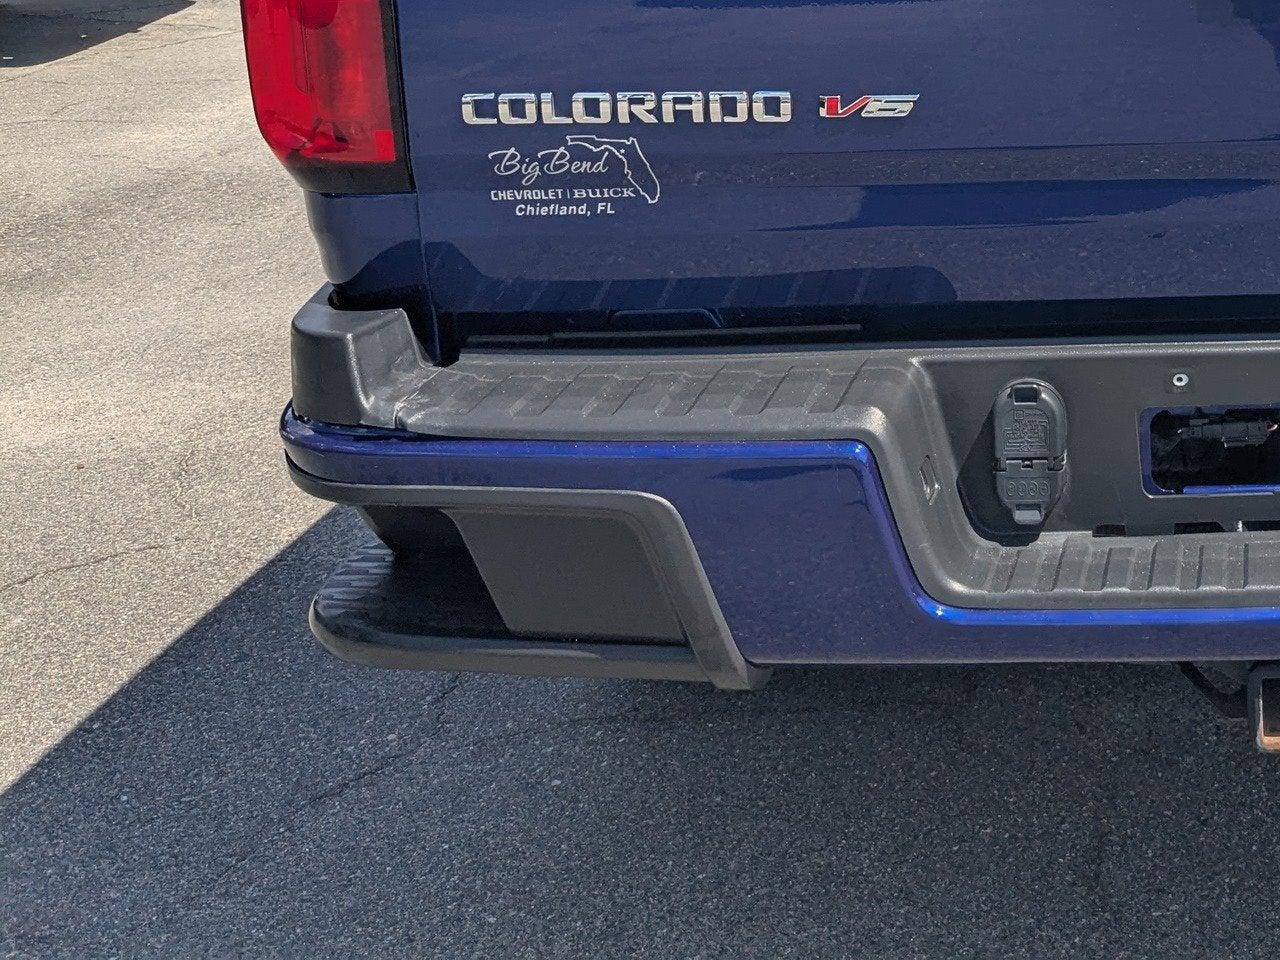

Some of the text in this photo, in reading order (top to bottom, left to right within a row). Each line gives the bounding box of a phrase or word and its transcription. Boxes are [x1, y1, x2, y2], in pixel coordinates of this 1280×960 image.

[461, 90, 920, 125] COLORADO V6
[487, 146, 610, 186] Big Bend
[490, 187, 637, 201] CHEVROLET BUICK
[515, 202, 616, 217] Chiefland, FL
